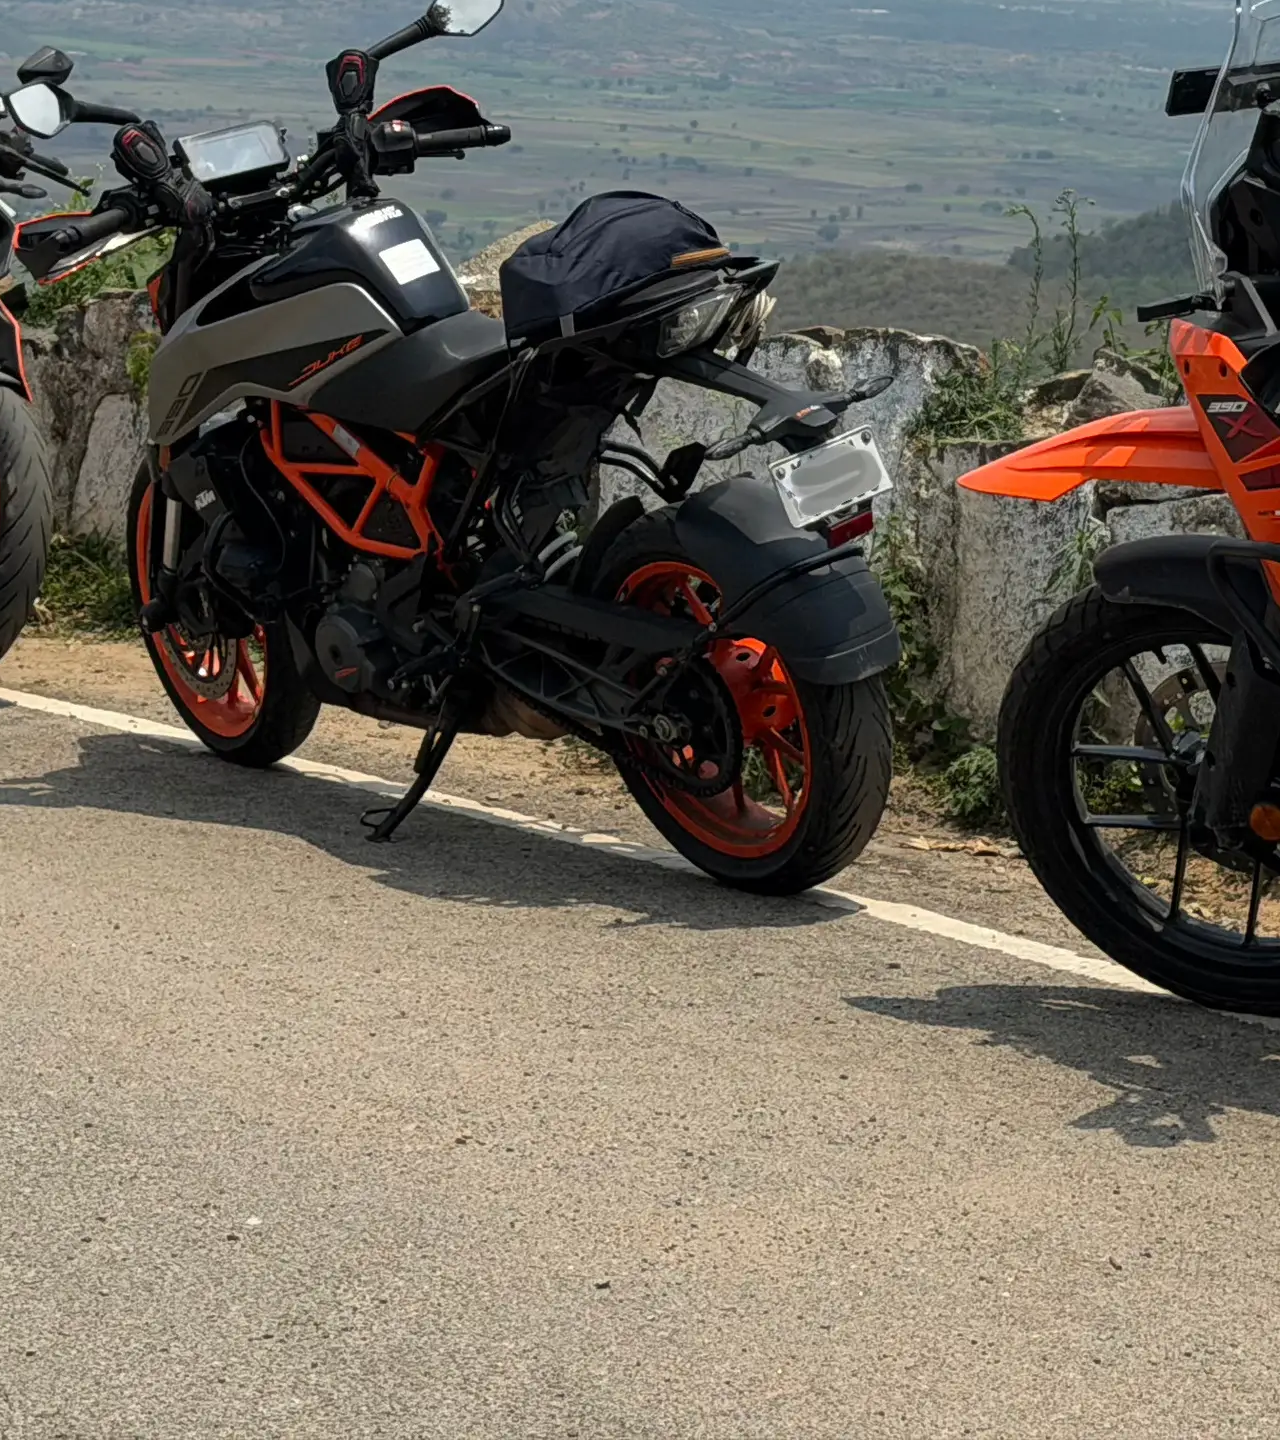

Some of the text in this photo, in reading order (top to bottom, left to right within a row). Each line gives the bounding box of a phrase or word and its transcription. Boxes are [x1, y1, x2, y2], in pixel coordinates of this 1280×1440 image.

[291, 335, 363, 384] DUKE
[1206, 401, 1249, 413] 390
[1217, 412, 1262, 439] X
[194, 490, 216, 511] KTM
